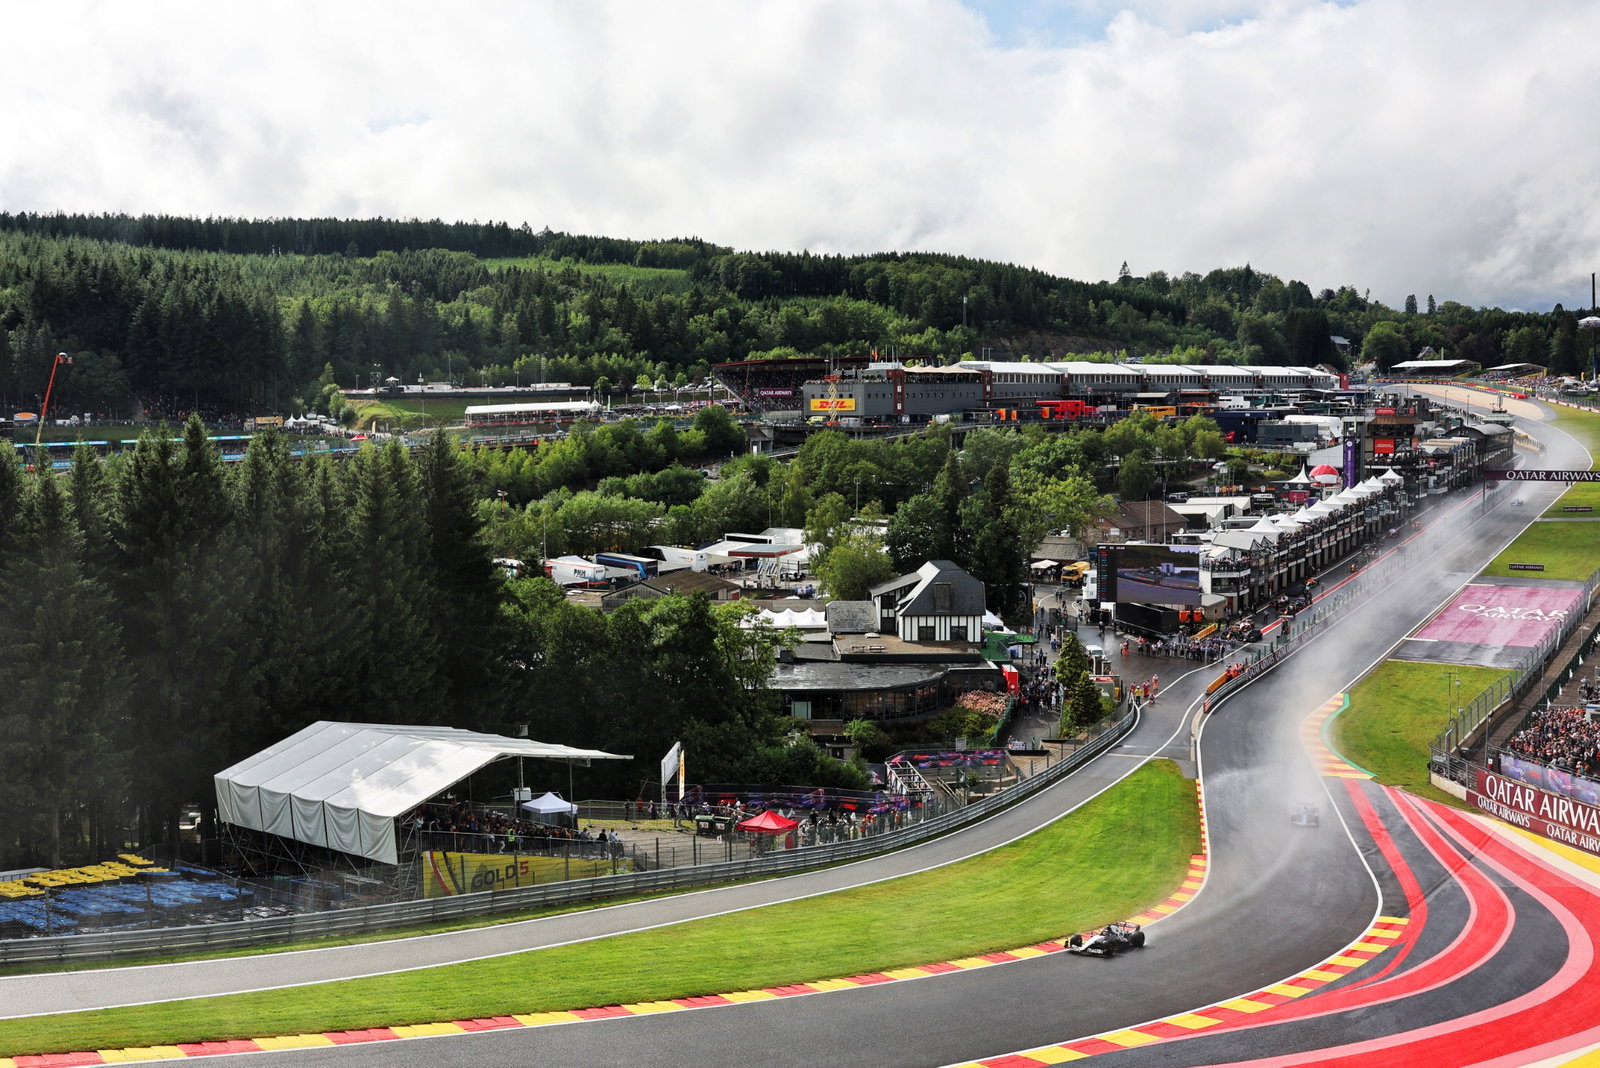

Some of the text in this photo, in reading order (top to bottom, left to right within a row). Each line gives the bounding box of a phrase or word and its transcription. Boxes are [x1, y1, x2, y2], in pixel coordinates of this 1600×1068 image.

[1506, 470, 1600, 481] QATAR AIRWAYS
[1458, 604, 1569, 617] QATAR
[1476, 612, 1565, 622] AIRWAYS
[1477, 796, 1531, 828] QATAR AIRWAYS
[1486, 775, 1600, 835] QATAR AIRWA
[1546, 823, 1578, 845] QATAR
[471, 860, 529, 888] GOLD 5
